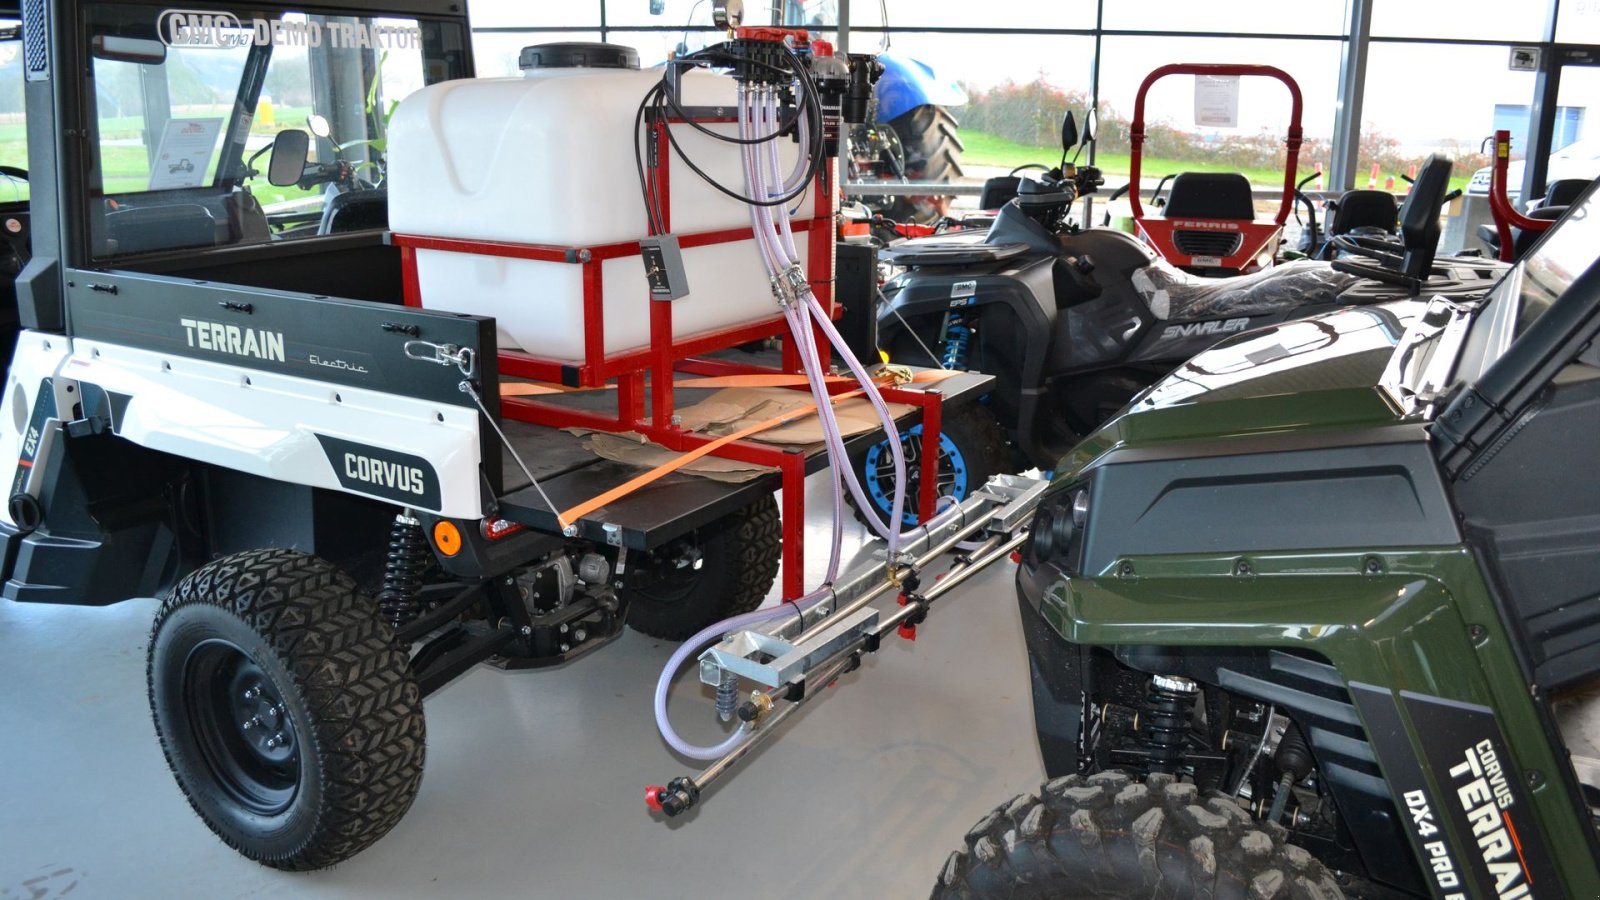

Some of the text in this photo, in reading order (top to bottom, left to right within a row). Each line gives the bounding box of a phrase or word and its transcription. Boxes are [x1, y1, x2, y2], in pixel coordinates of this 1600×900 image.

[168, 13, 423, 50] GMC DEMO TRAKTOR
[1173, 221, 1239, 230] FERRIS
[180, 318, 286, 363] TERRAIN
[1160, 317, 1250, 339] SNARLER
[309, 354, 369, 374] Electric
[25, 426, 39, 457] EX4
[344, 452, 424, 495] CORVUS
[1476, 738, 1514, 810] CORVUS
[1403, 789, 1438, 837] DX4
[1424, 840, 1459, 889] PRO
[1449, 747, 1534, 900] TERRAI
